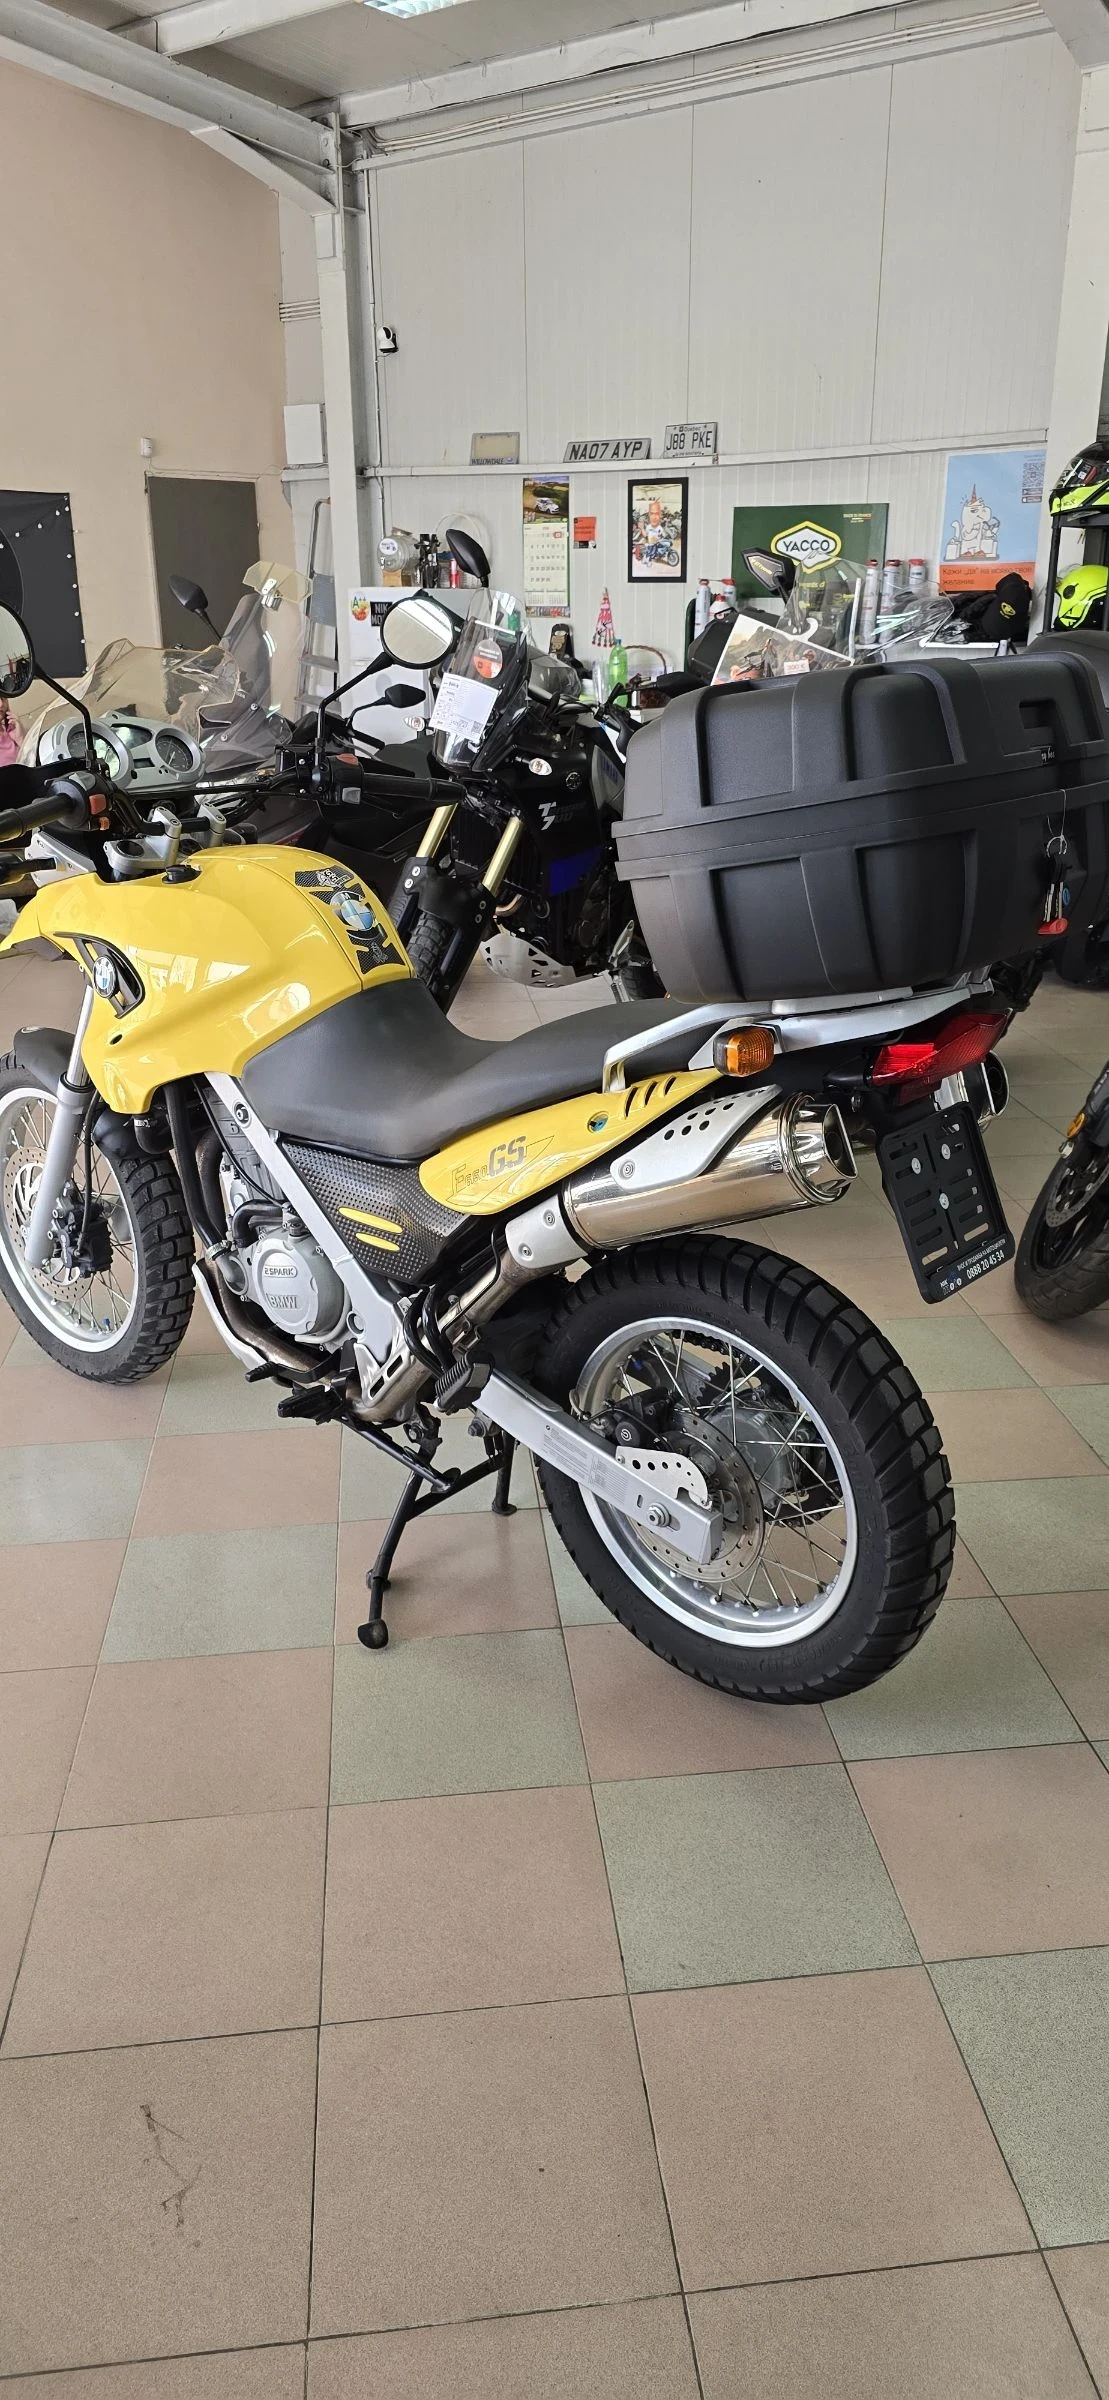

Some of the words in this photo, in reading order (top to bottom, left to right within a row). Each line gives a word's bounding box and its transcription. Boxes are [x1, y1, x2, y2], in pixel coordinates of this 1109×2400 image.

[666, 433, 686, 450] J88
[691, 431, 713, 449] PKE
[611, 441, 643, 459] AYP
[782, 540, 831, 552] YACCO
[488, 1136, 527, 1177] GS
[966, 1264, 982, 1279] 0888
[981, 1259, 990, 1271] 20
[989, 1255, 997, 1265] 45
[996, 1249, 1005, 1261] 34
[269, 1295, 298, 1309] BMW
